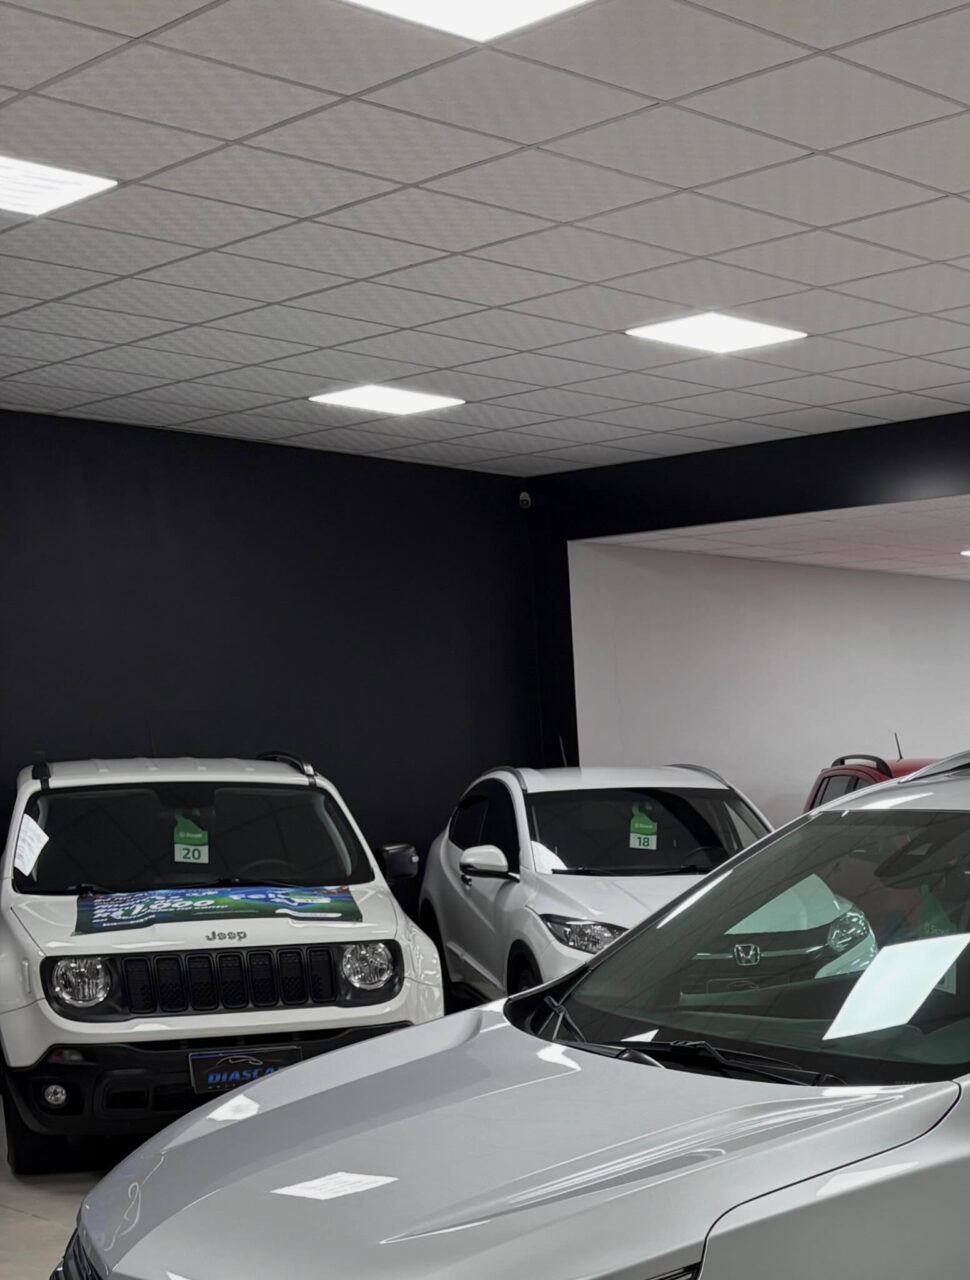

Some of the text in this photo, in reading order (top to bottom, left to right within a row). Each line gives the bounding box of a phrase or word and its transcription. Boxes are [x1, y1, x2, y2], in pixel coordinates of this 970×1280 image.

[636, 836, 650, 848] 18
[182, 847, 202, 861] 20
[205, 930, 248, 942] Jeep
[207, 1066, 284, 1084] DIASCA
